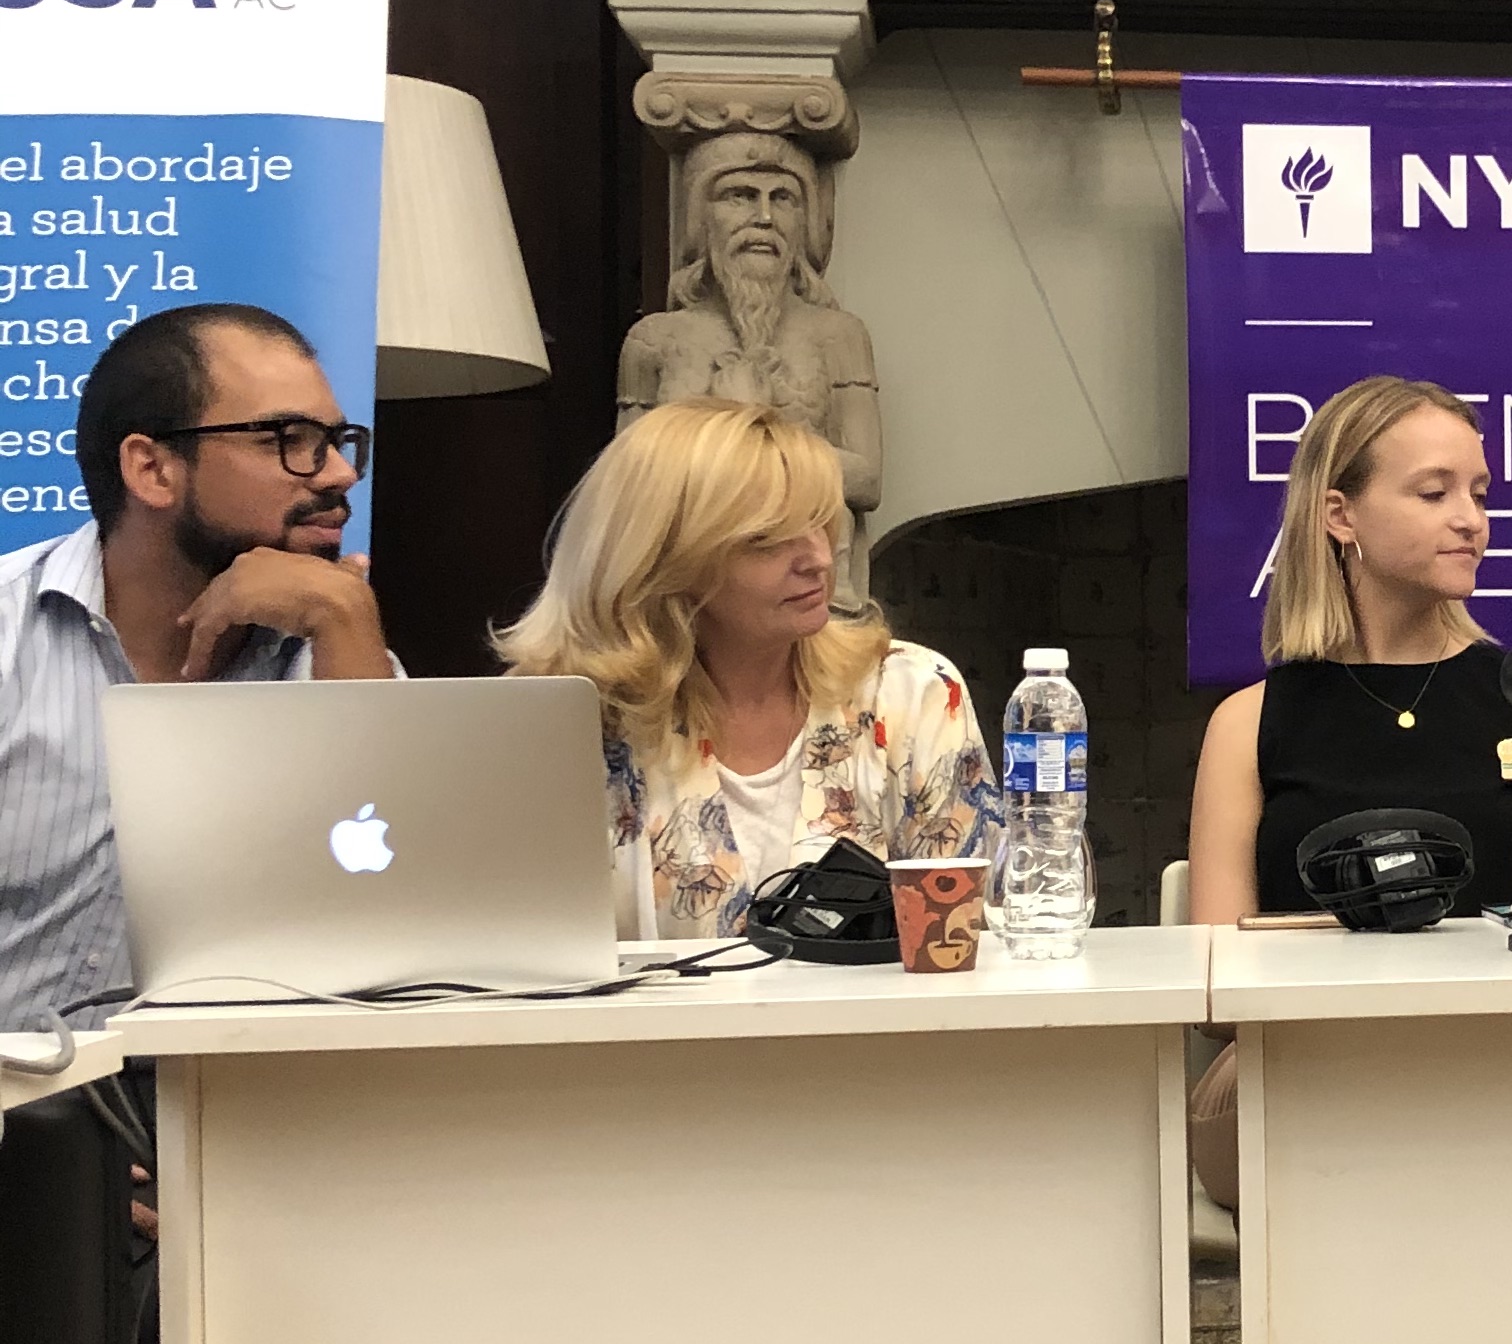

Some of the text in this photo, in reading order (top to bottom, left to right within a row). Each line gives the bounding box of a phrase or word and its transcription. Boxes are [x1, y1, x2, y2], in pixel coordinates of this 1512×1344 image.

[0, 141, 293, 192] el abordaje
[31, 195, 179, 236] salud
[103, 264, 138, 301] y
[151, 250, 198, 291] la
